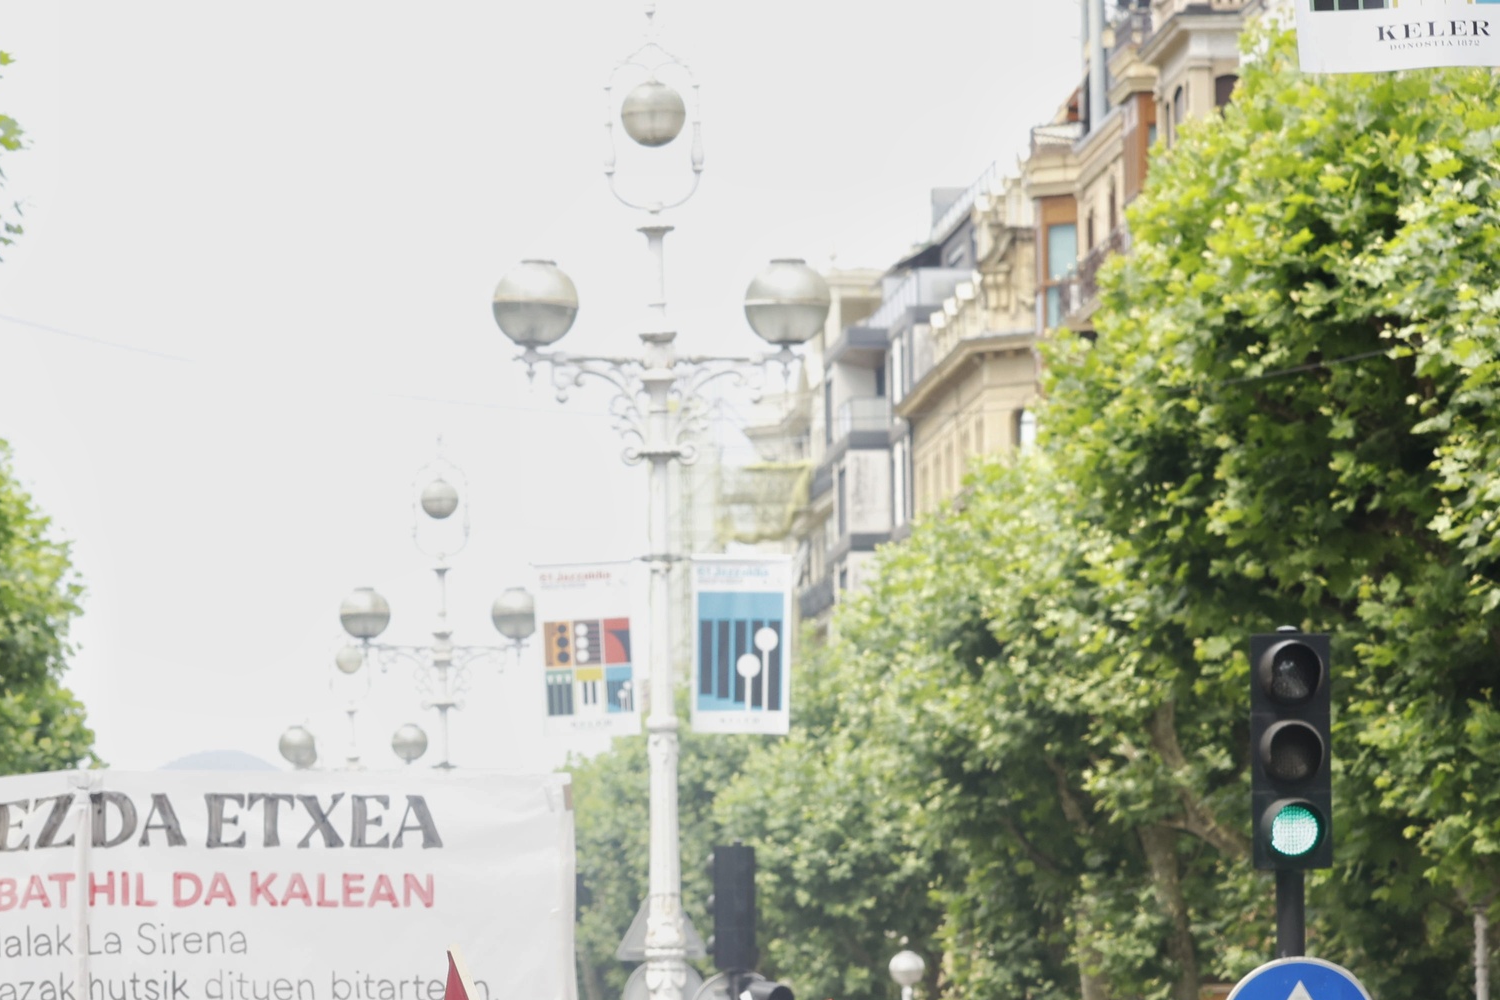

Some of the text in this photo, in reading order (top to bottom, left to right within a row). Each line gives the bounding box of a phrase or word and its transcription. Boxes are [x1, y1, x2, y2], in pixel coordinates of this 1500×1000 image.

[1377, 20, 1490, 41] KELER
[1390, 39, 1480, 51] DONOSTIA 1872
[89, 790, 188, 849] DA
[204, 792, 444, 850] ETXEA
[88, 870, 157, 908] HIL
[172, 871, 237, 908] DA
[249, 870, 435, 908] KALEAN
[86, 923, 122, 956] La
[137, 922, 248, 956] Sirena
